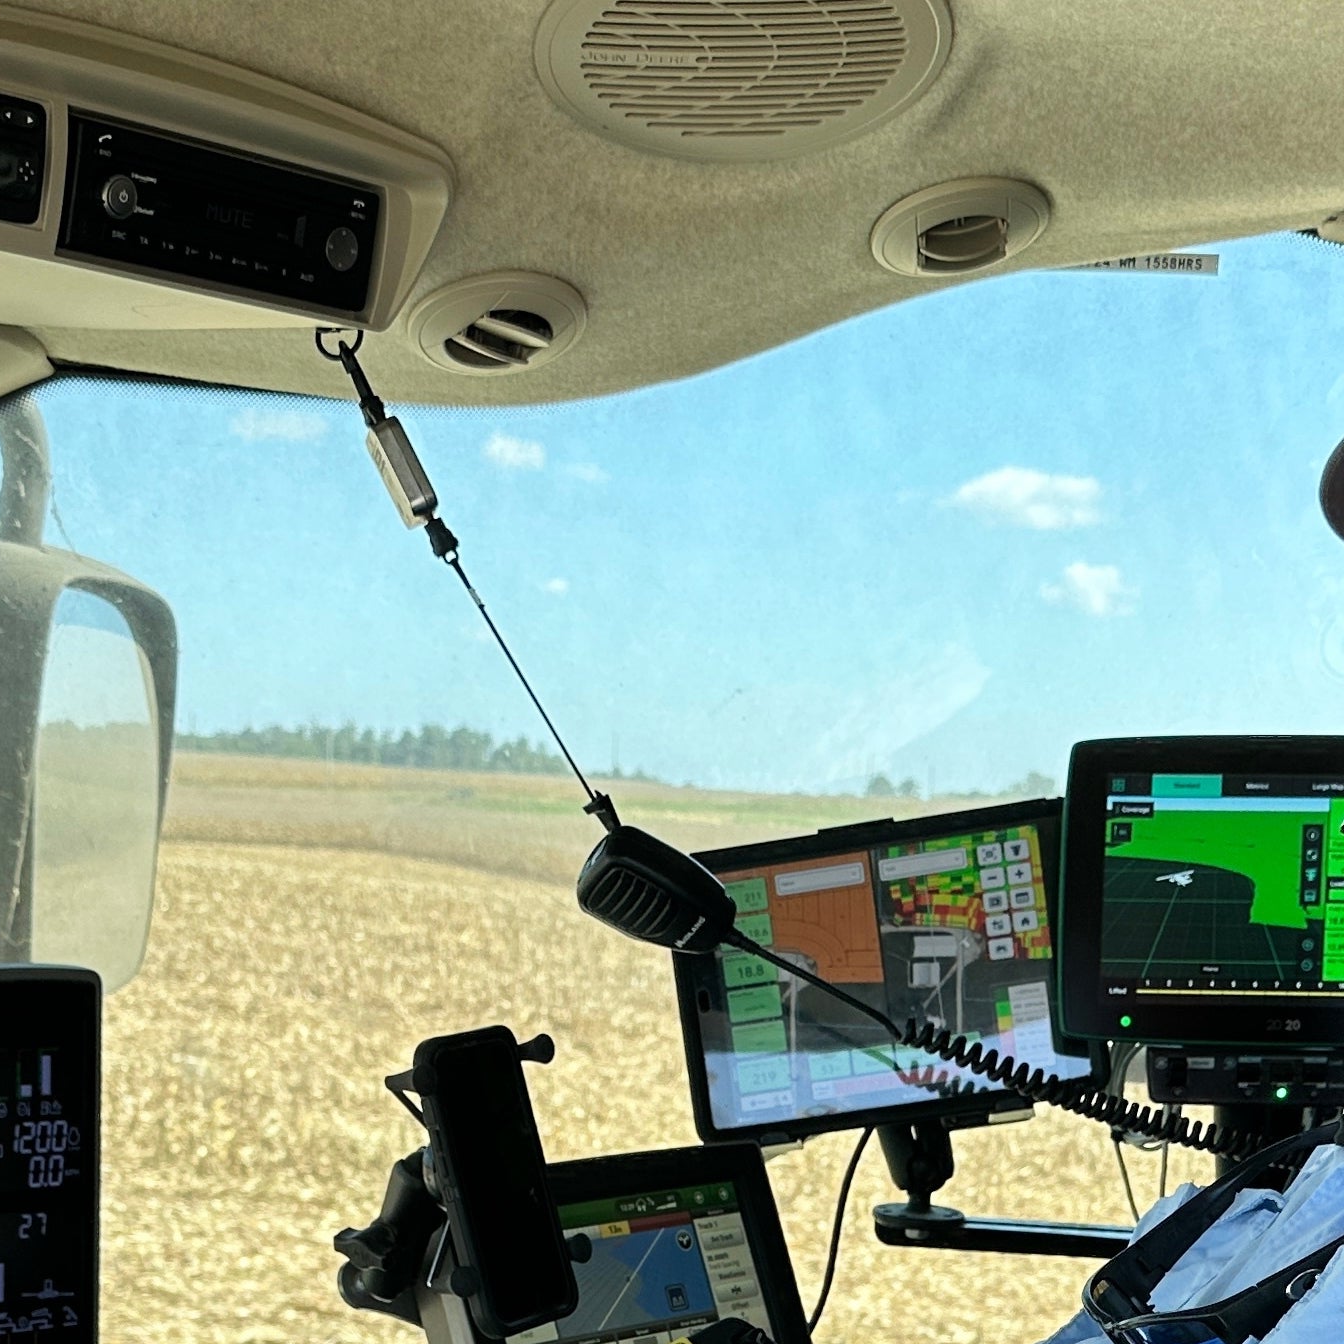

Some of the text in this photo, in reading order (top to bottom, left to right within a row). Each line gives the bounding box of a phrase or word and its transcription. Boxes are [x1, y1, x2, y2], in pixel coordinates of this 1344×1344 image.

[205, 201, 255, 230] MUTE
[1145, 257, 1202, 271] 1558HRS
[1120, 805, 1151, 815] Coverage
[737, 964, 765, 979] 18.8
[12, 1119, 69, 1155] 1200
[27, 1154, 65, 1189] 0.0
[17, 1212, 48, 1240] 27
